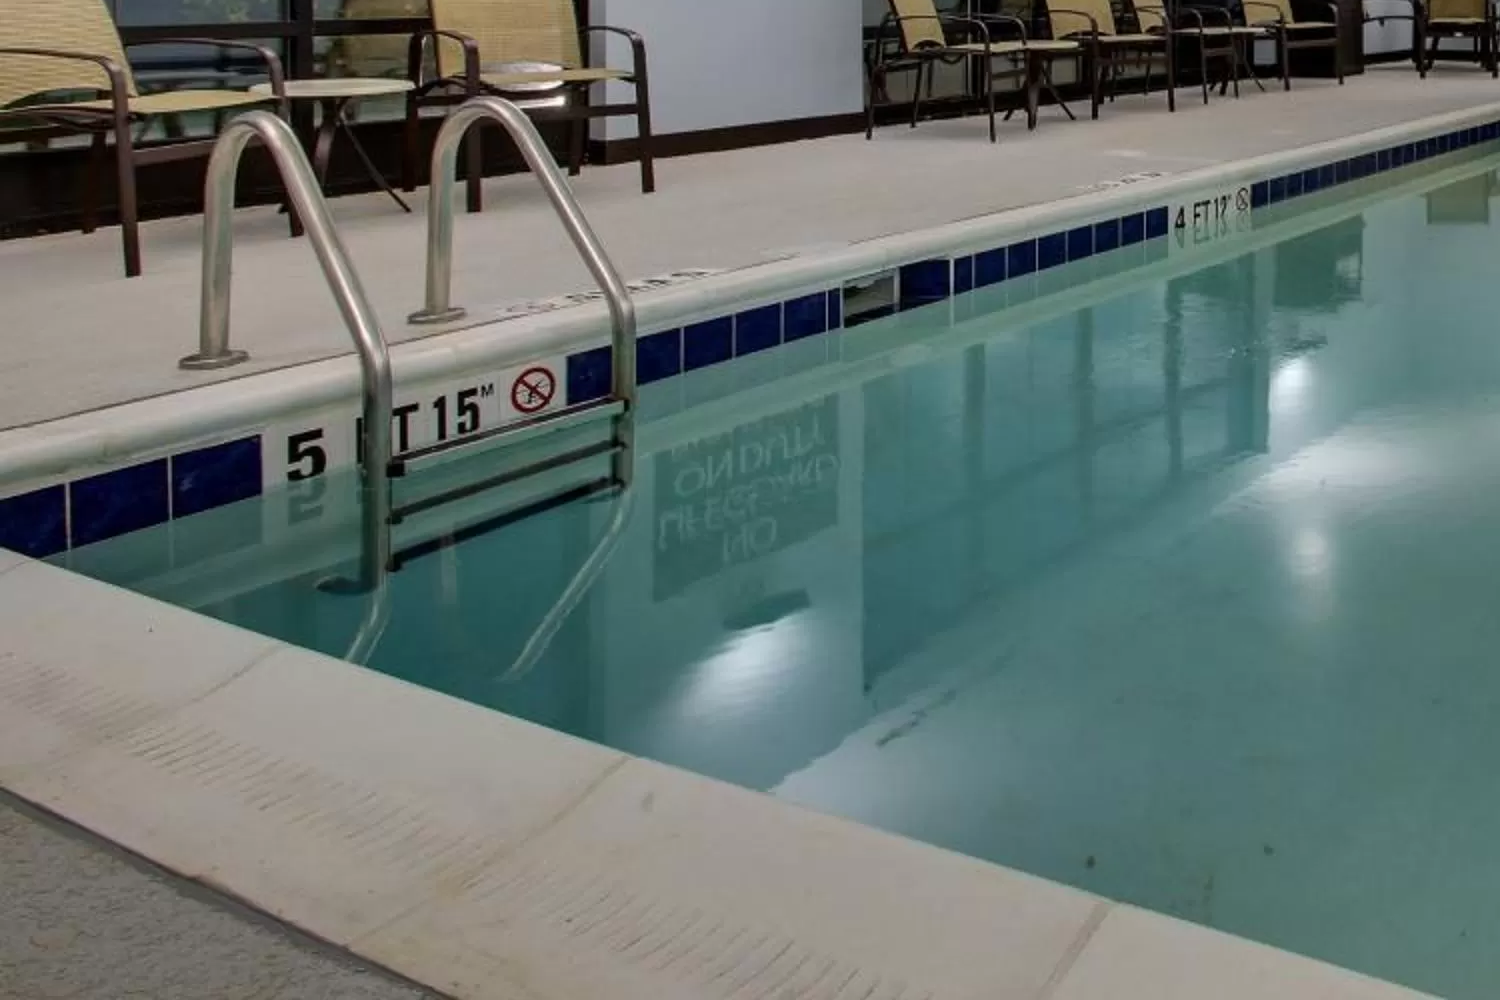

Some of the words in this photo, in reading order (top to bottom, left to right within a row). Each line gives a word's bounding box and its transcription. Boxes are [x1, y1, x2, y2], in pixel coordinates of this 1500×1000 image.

[1174, 206, 1186, 229] 4
[1193, 200, 1211, 226] FT
[287, 427, 327, 482] 5
